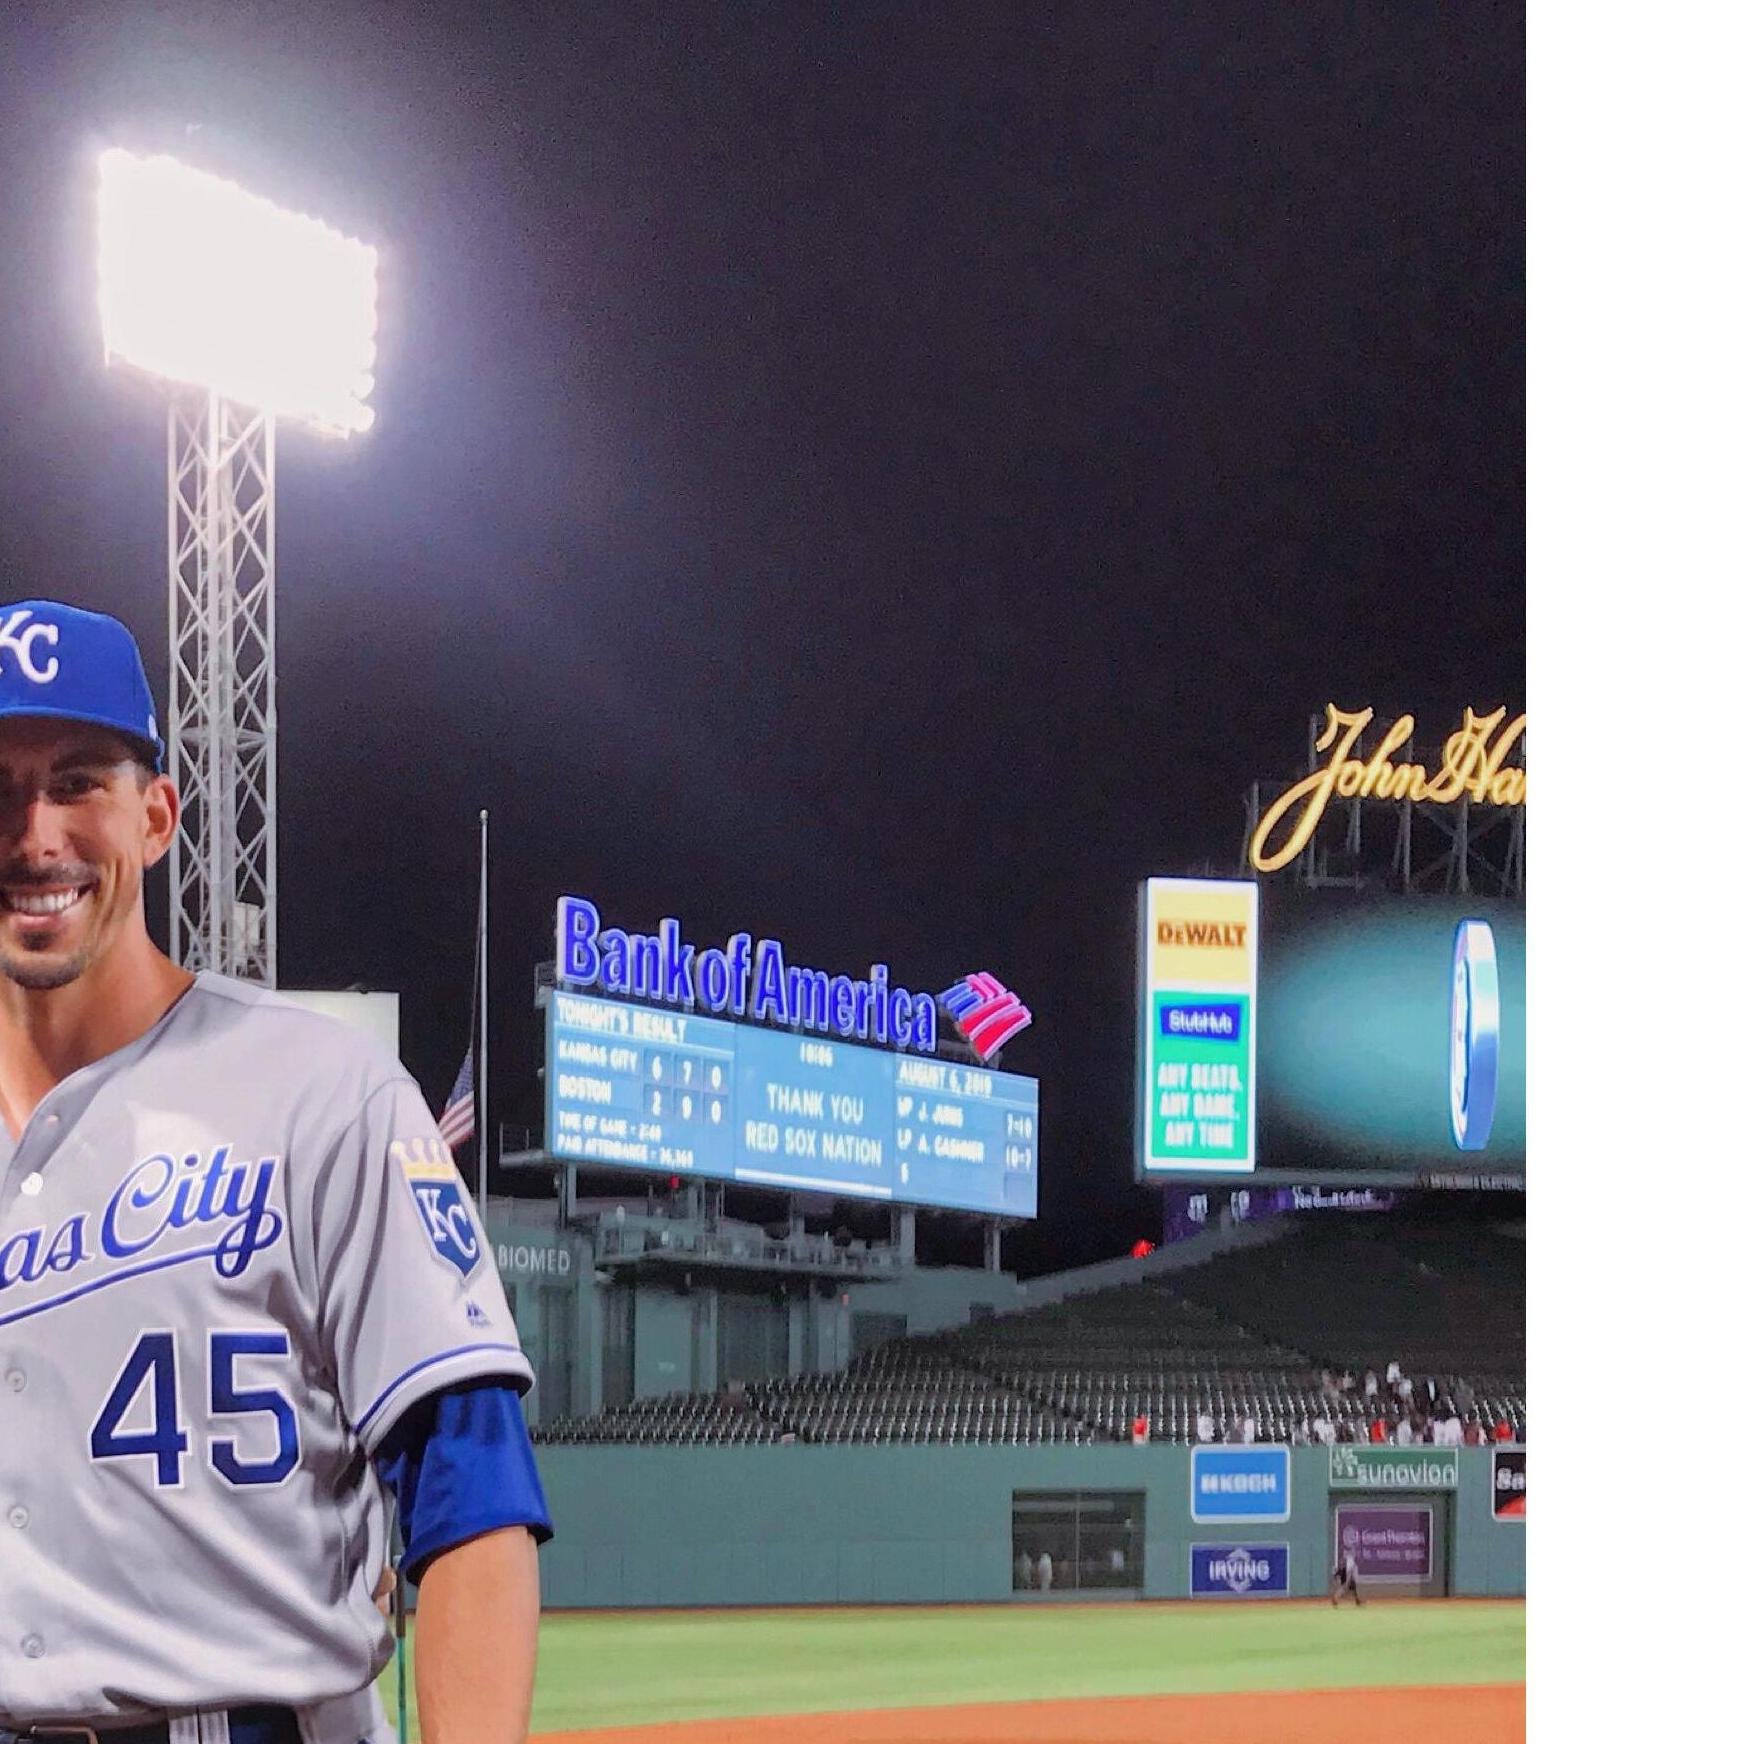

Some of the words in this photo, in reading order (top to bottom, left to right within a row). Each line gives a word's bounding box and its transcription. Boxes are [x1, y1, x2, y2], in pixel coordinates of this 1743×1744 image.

[1248, 702, 1428, 872] John
[1426, 705, 1526, 806] Ha
[557, 896, 696, 1007] Bank
[695, 932, 753, 1017] of
[756, 939, 938, 1053] America
[559, 1073, 612, 1105] BOSTON
[767, 1082, 824, 1120] THANK
[831, 1093, 865, 1126] YOU
[746, 1119, 779, 1154] RED
[785, 1126, 817, 1158] SOX
[822, 1132, 883, 1168] NATION
[100, 1144, 284, 1279] City
[416, 1188, 478, 1260] KC
[494, 1244, 572, 1276] BIOMED
[88, 1327, 303, 1490] 45
[1357, 1458, 1456, 1486] sunovion
[1209, 1558, 1270, 1582] IRVING
